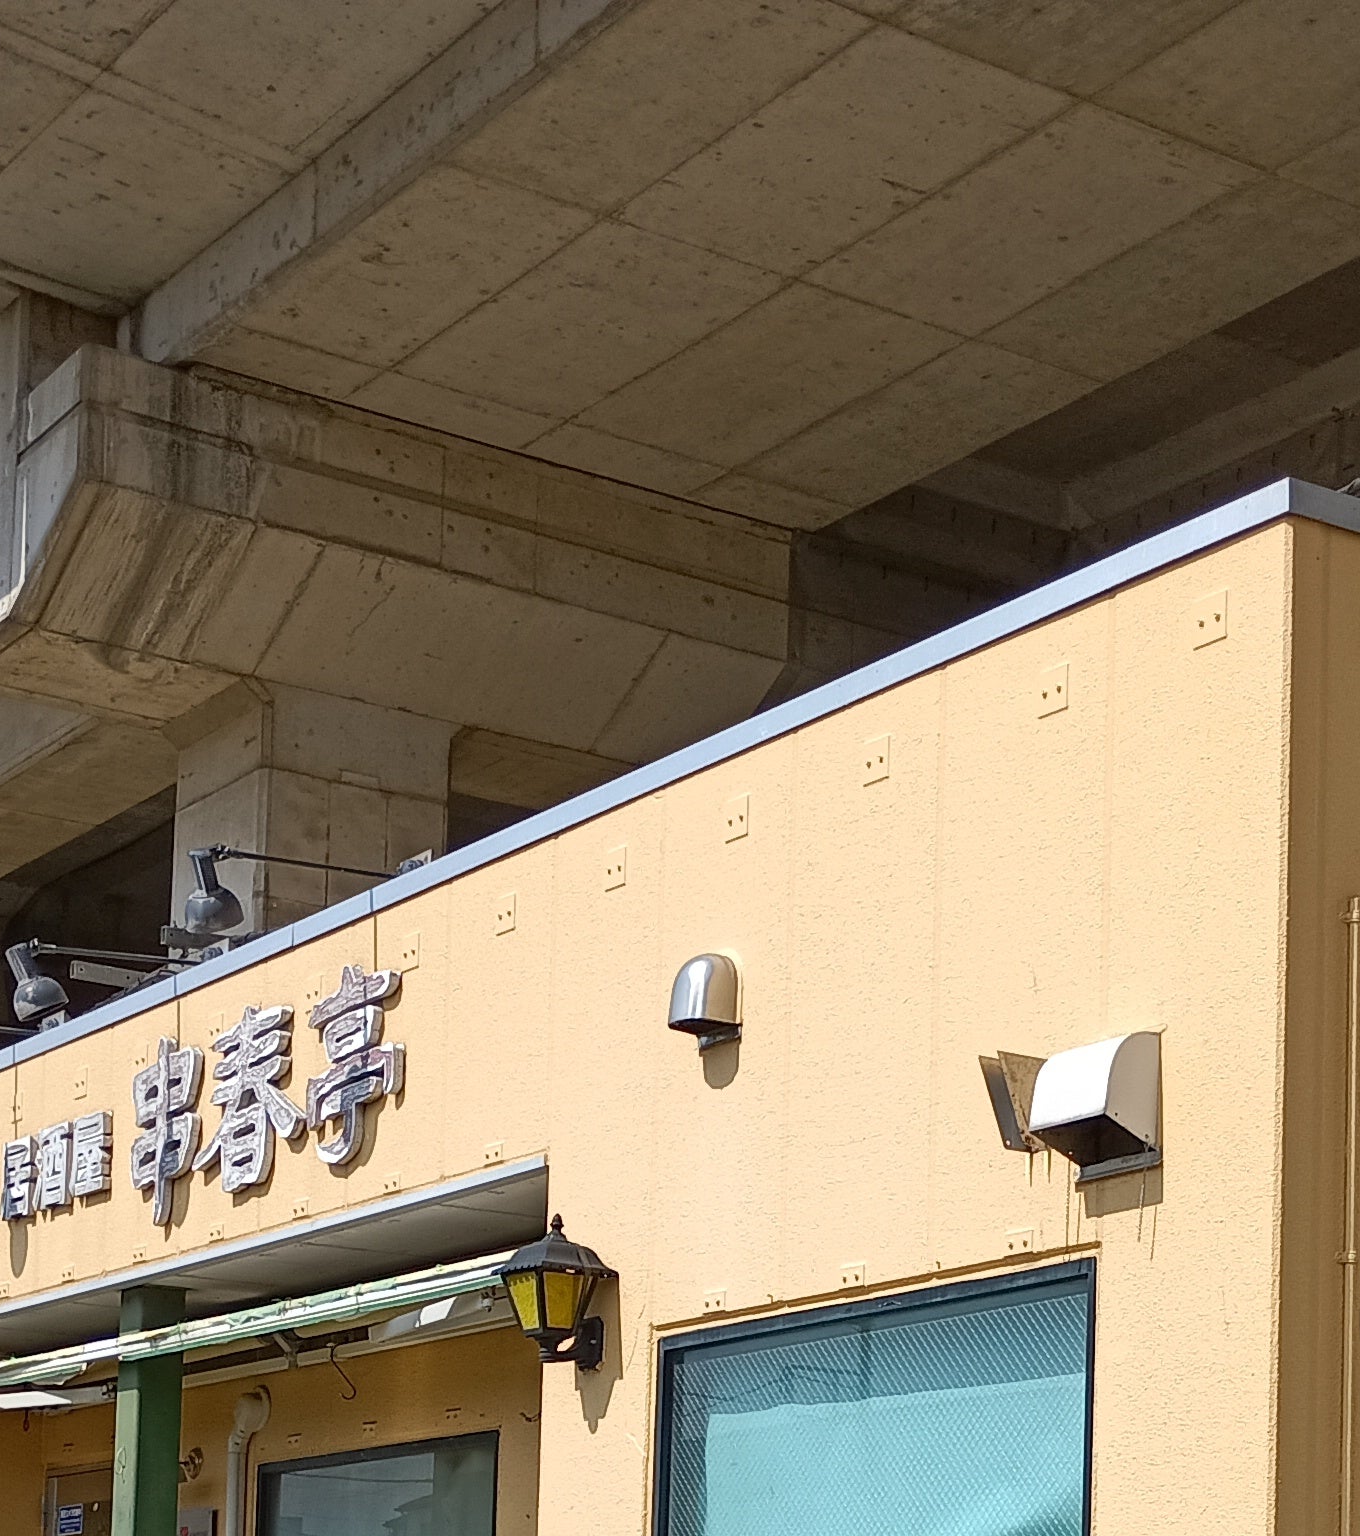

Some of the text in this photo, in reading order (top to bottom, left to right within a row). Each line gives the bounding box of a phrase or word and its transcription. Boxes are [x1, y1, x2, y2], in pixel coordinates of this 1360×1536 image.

[1, 964, 406, 1227] 居酒屋 串春亭
